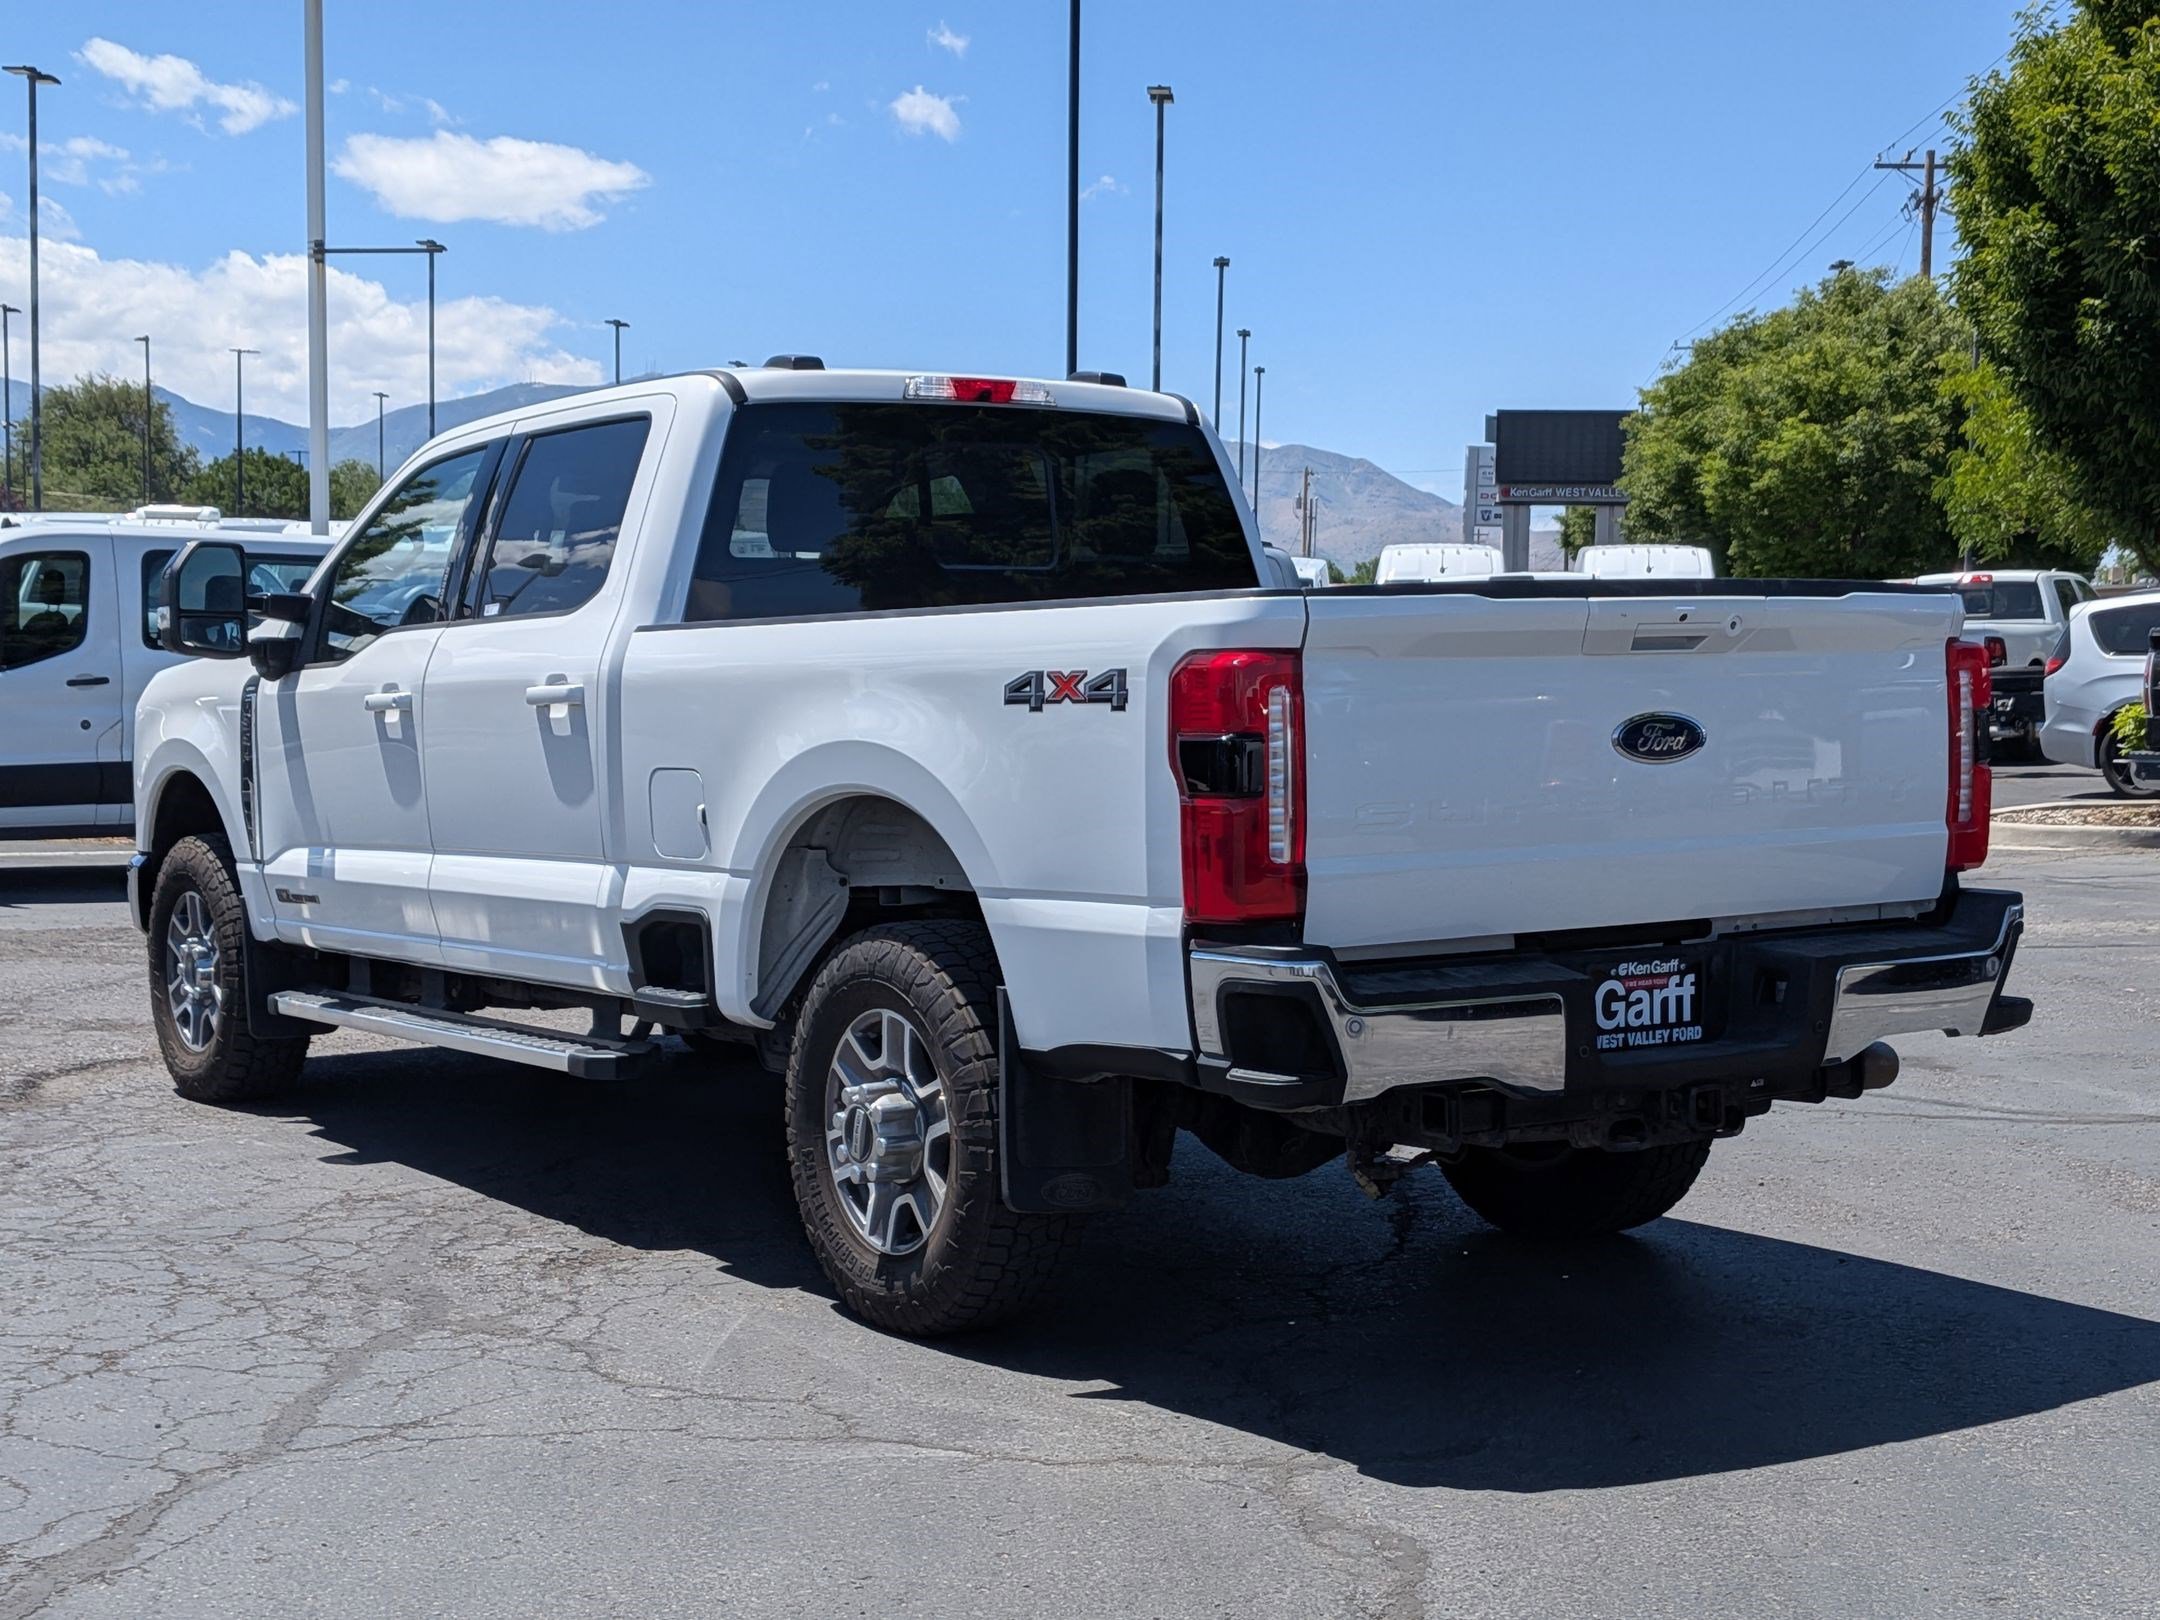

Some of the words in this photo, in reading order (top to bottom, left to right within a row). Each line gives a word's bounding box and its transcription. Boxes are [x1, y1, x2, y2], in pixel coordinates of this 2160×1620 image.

[1555, 487, 1586, 497] WEST
[1637, 723, 1688, 752] Ford
[1595, 973, 1696, 1030] Garff
[1627, 1029, 1671, 1046] VALLEY
[1672, 1026, 1702, 1042] FORD
